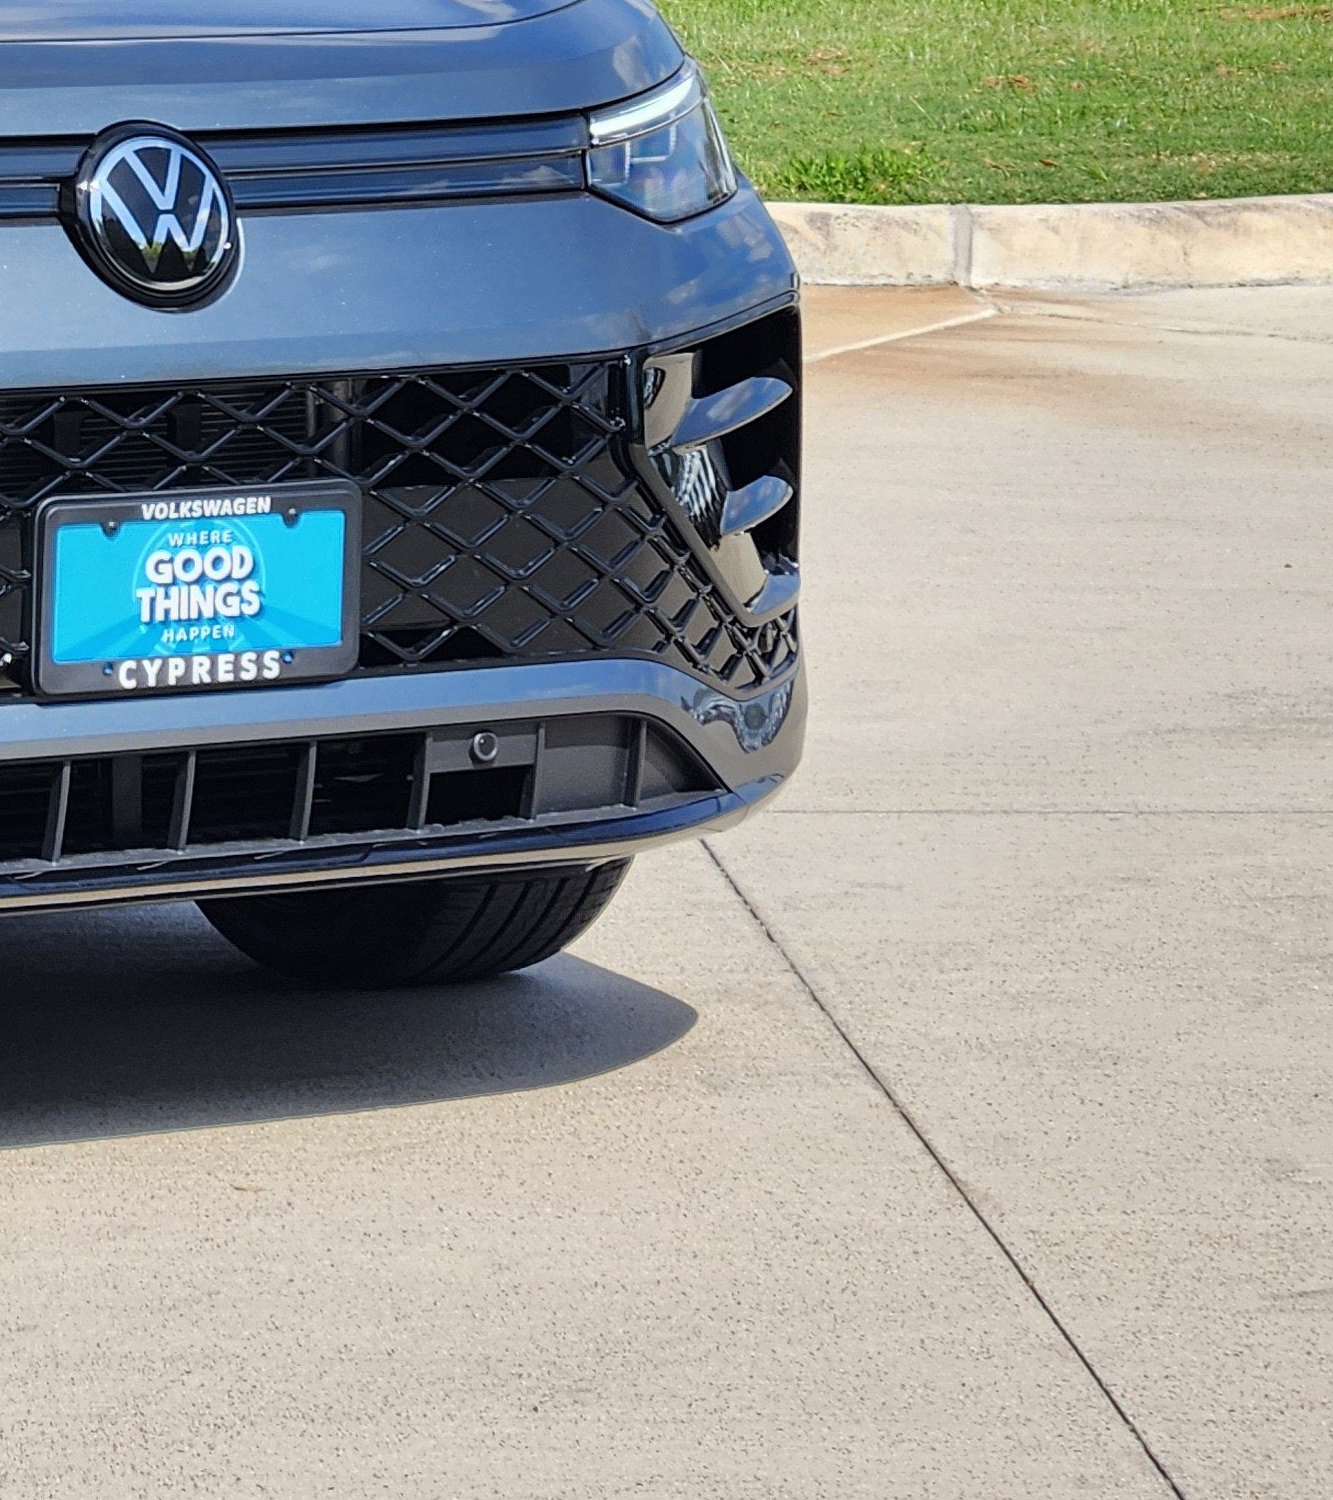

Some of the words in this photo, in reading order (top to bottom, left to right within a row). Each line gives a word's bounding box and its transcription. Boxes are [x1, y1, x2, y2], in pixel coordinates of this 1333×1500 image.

[142, 497, 271, 520] VOLKSWAGEN
[168, 530, 232, 546] WHERE
[145, 546, 253, 584] GOOD
[137, 581, 260, 622] THINGS
[163, 625, 234, 642] HAPPEN
[119, 651, 280, 689] CYPRESS
